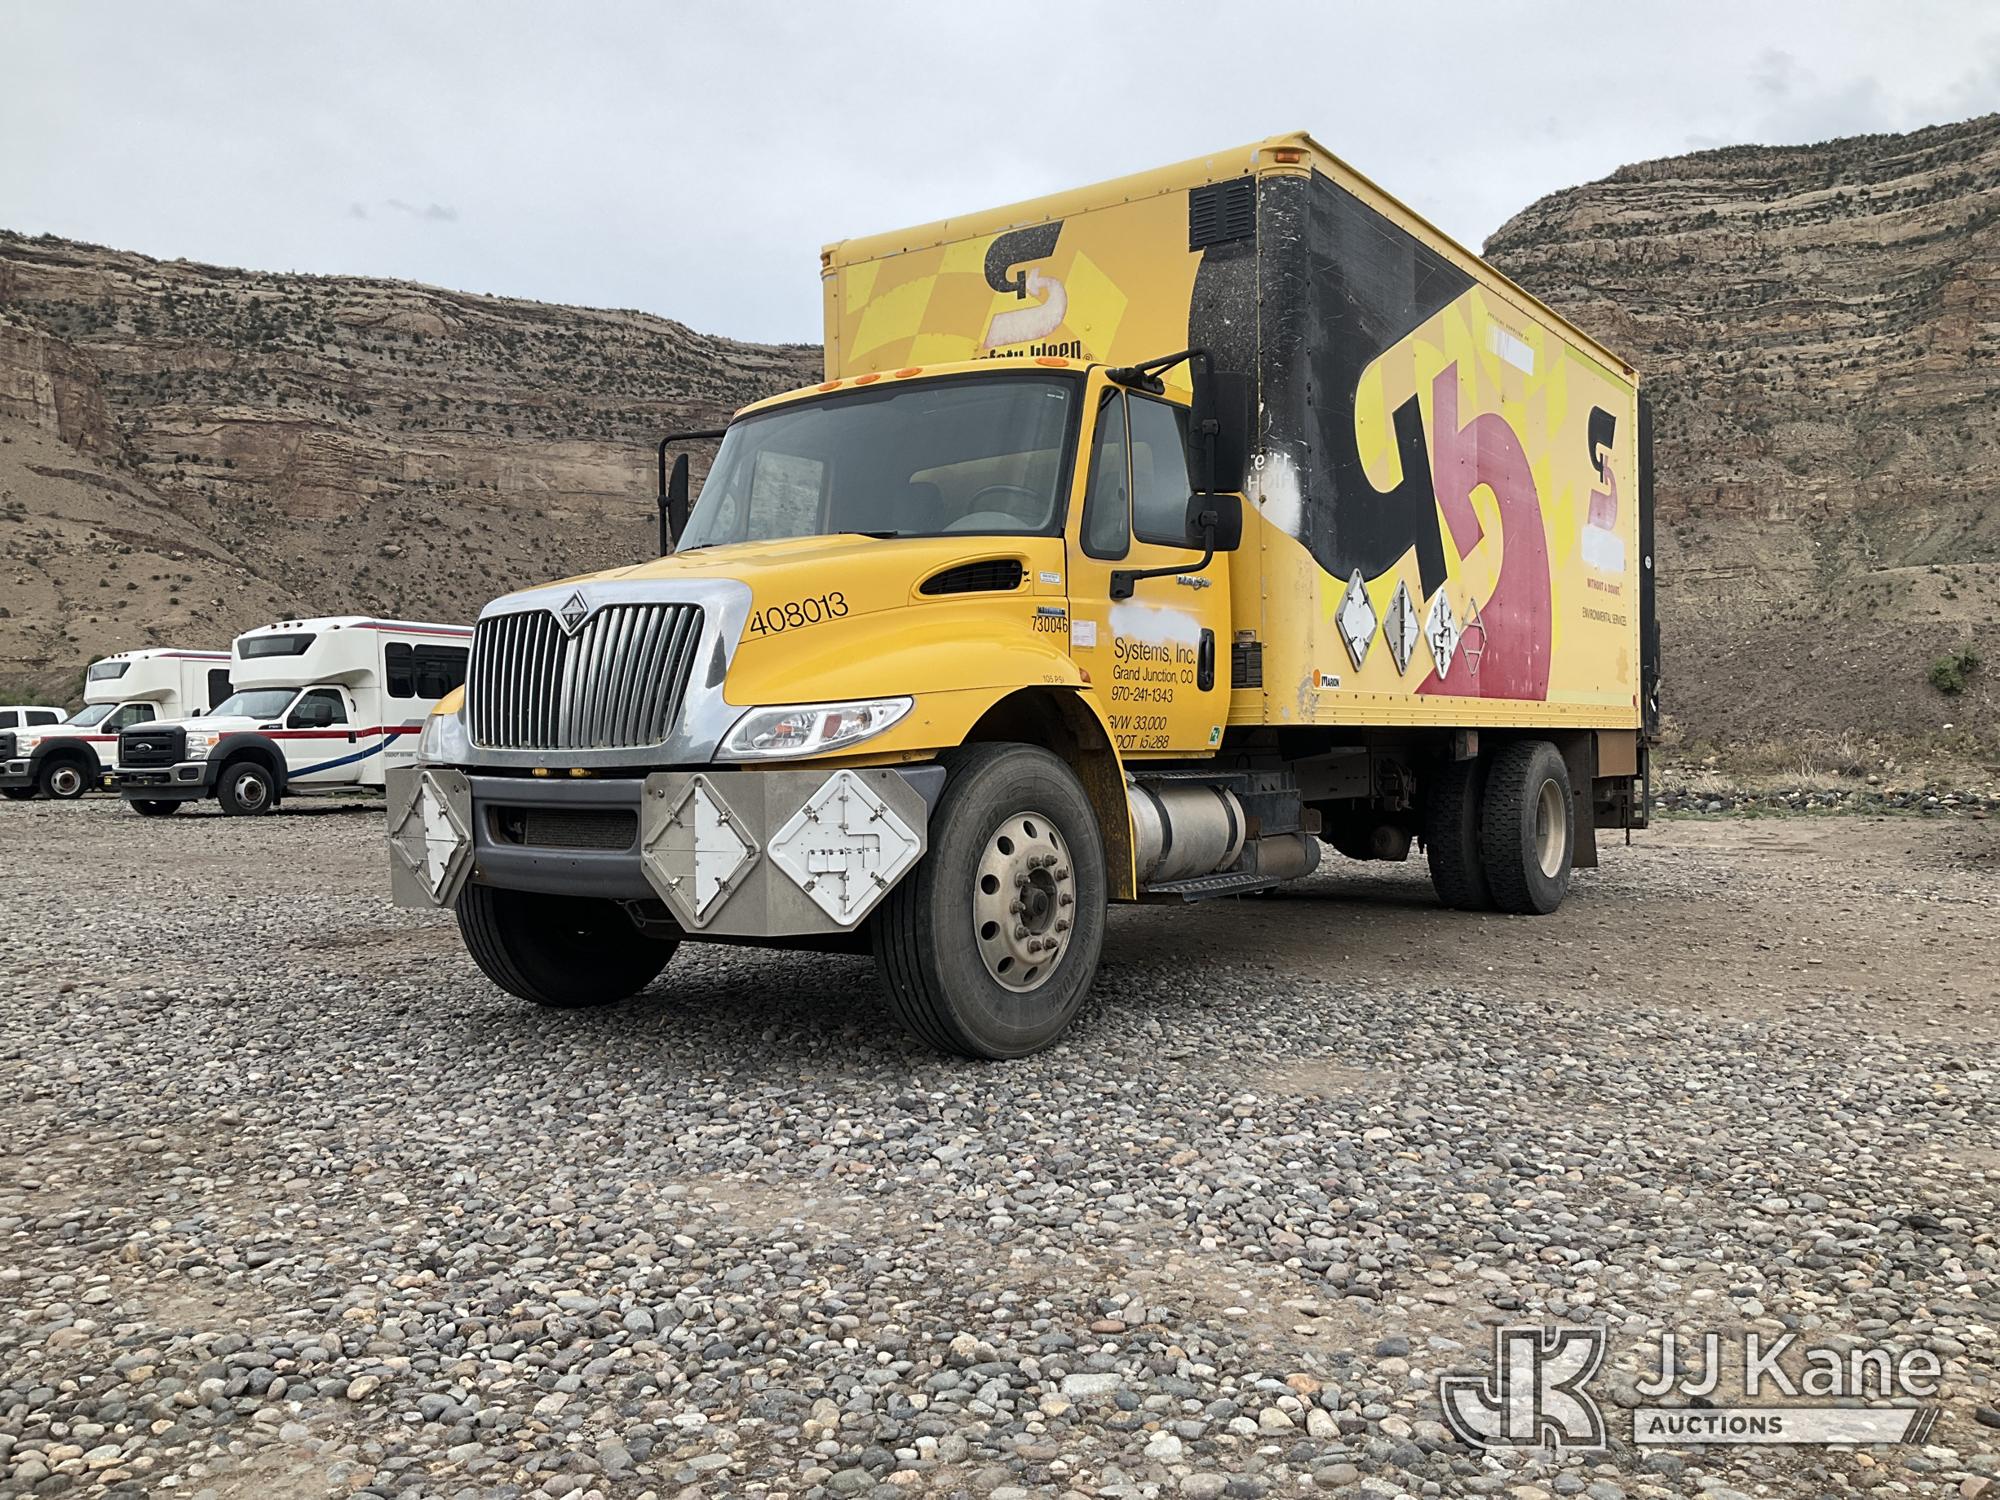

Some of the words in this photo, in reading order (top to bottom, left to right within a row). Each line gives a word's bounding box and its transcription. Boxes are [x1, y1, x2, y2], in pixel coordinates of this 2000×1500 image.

[750, 591, 849, 635] 408013
[1031, 615, 1069, 633] 730046
[1114, 636, 1172, 665] Systems,
[1176, 642, 1196, 665] Inc.
[1113, 664, 1141, 681] Grand
[1142, 667, 1178, 685] Junction,
[1181, 669, 1194, 684] CO
[1111, 685, 1173, 703] 970-241-1343
[1133, 715, 1167, 731] 33,000
